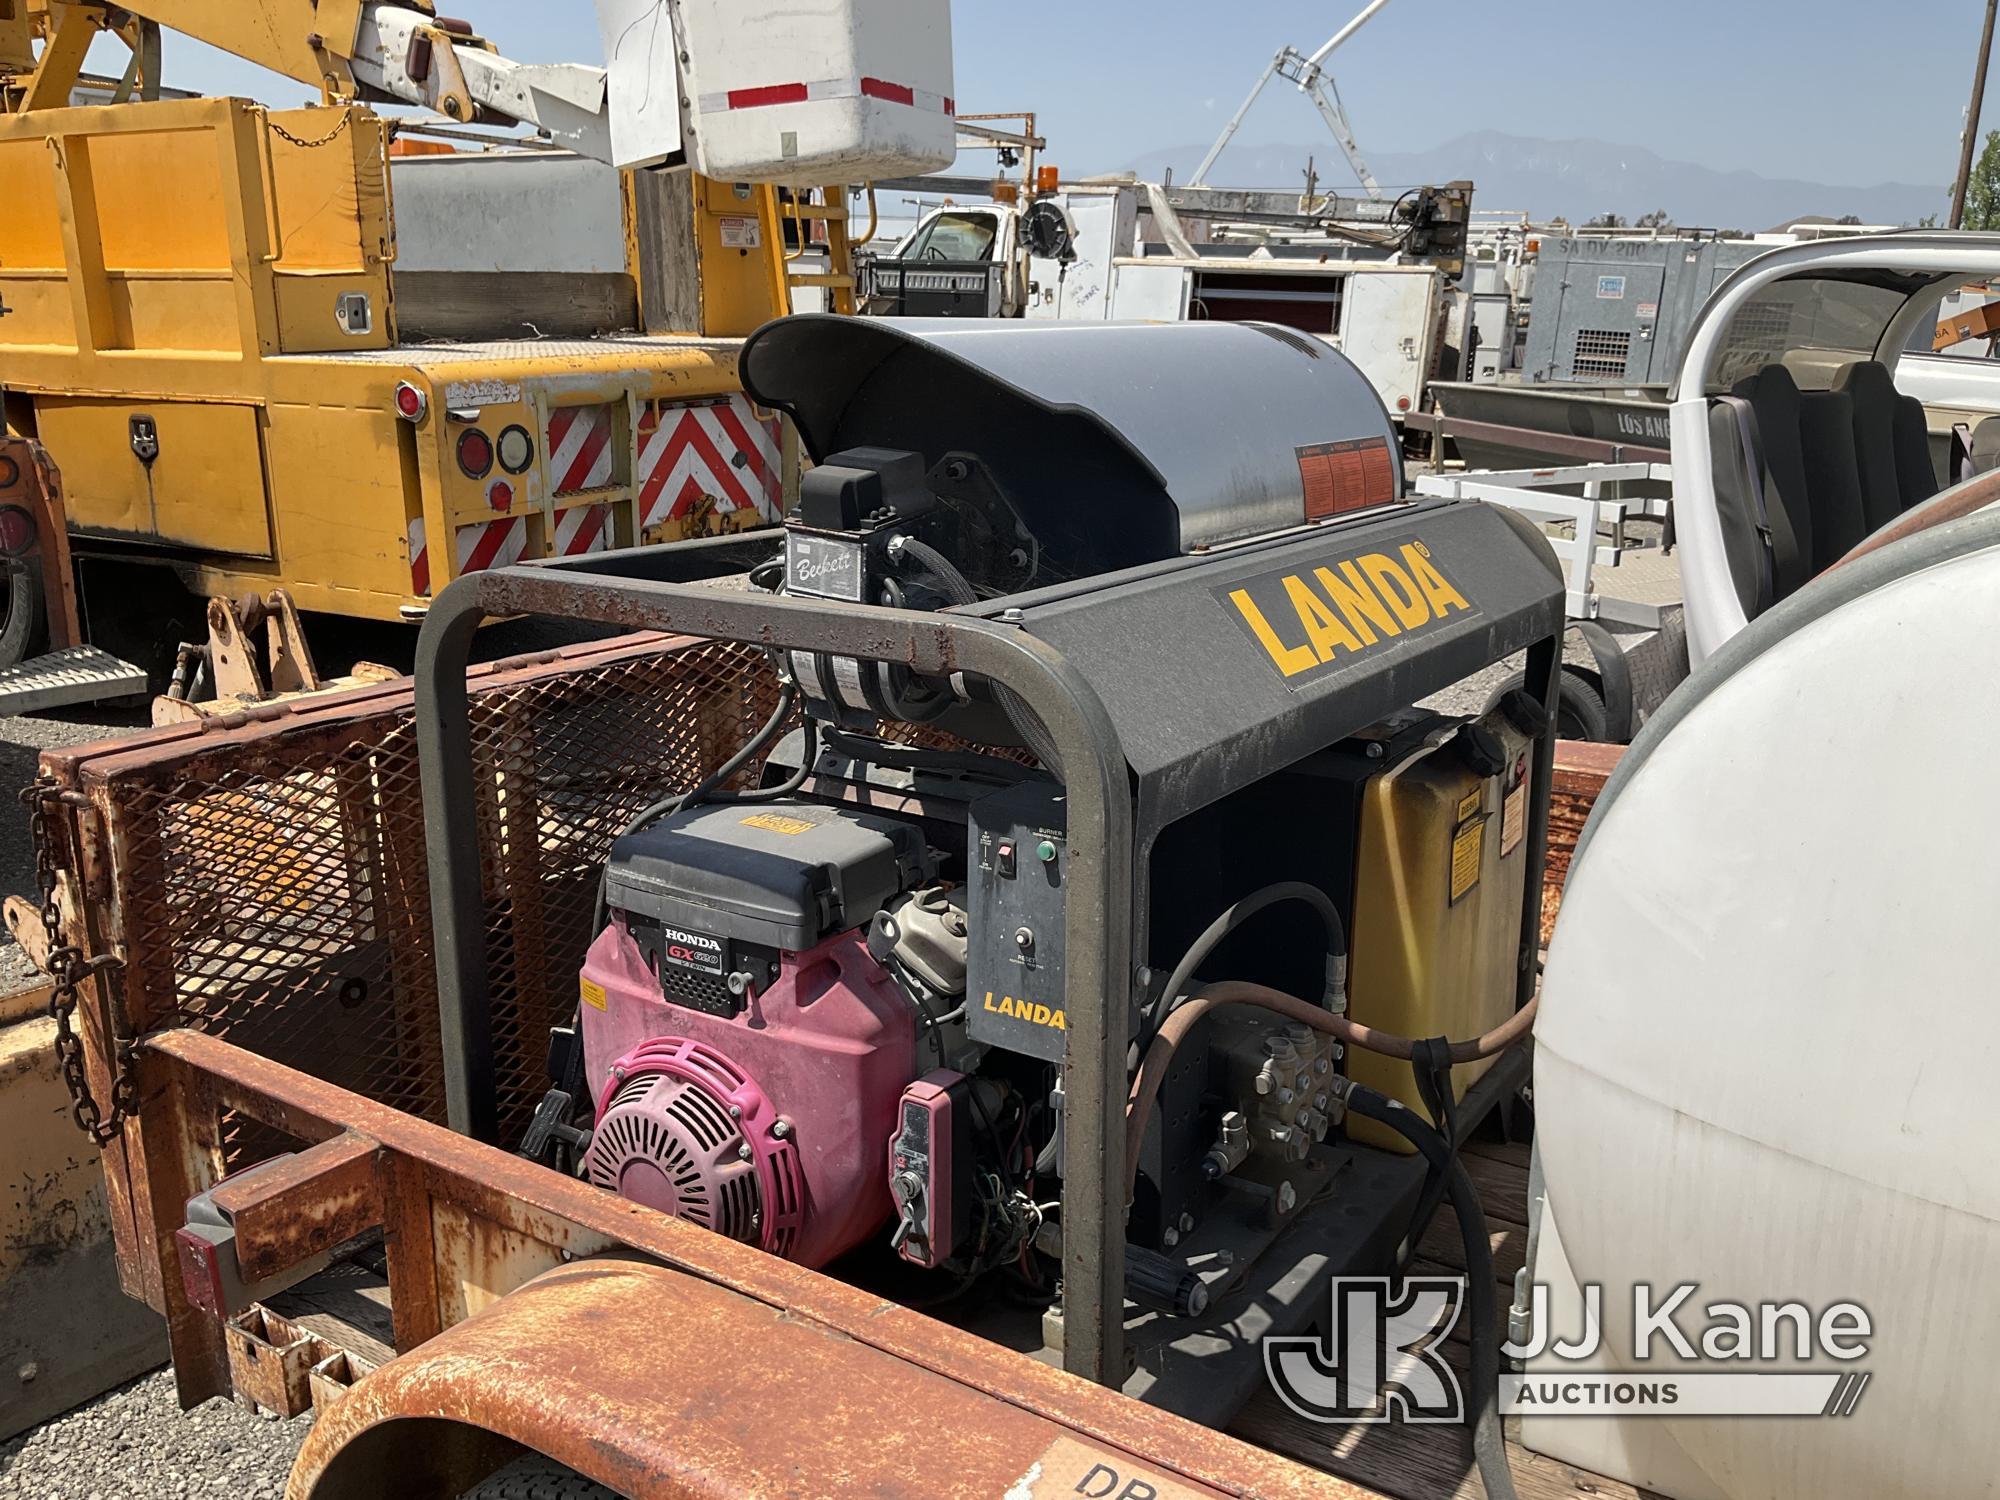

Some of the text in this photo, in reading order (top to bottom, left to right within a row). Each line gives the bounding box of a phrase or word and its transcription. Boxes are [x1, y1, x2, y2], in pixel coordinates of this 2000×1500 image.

[1617, 412, 1643, 435] LOS
[797, 552, 850, 580] Beckett
[1229, 543, 1470, 677] LANDA
[1039, 827, 1063, 836] BURNER
[665, 928, 721, 951] HONDA
[1017, 954, 1036, 963] RESET
[983, 991, 1066, 1030] LANDA
